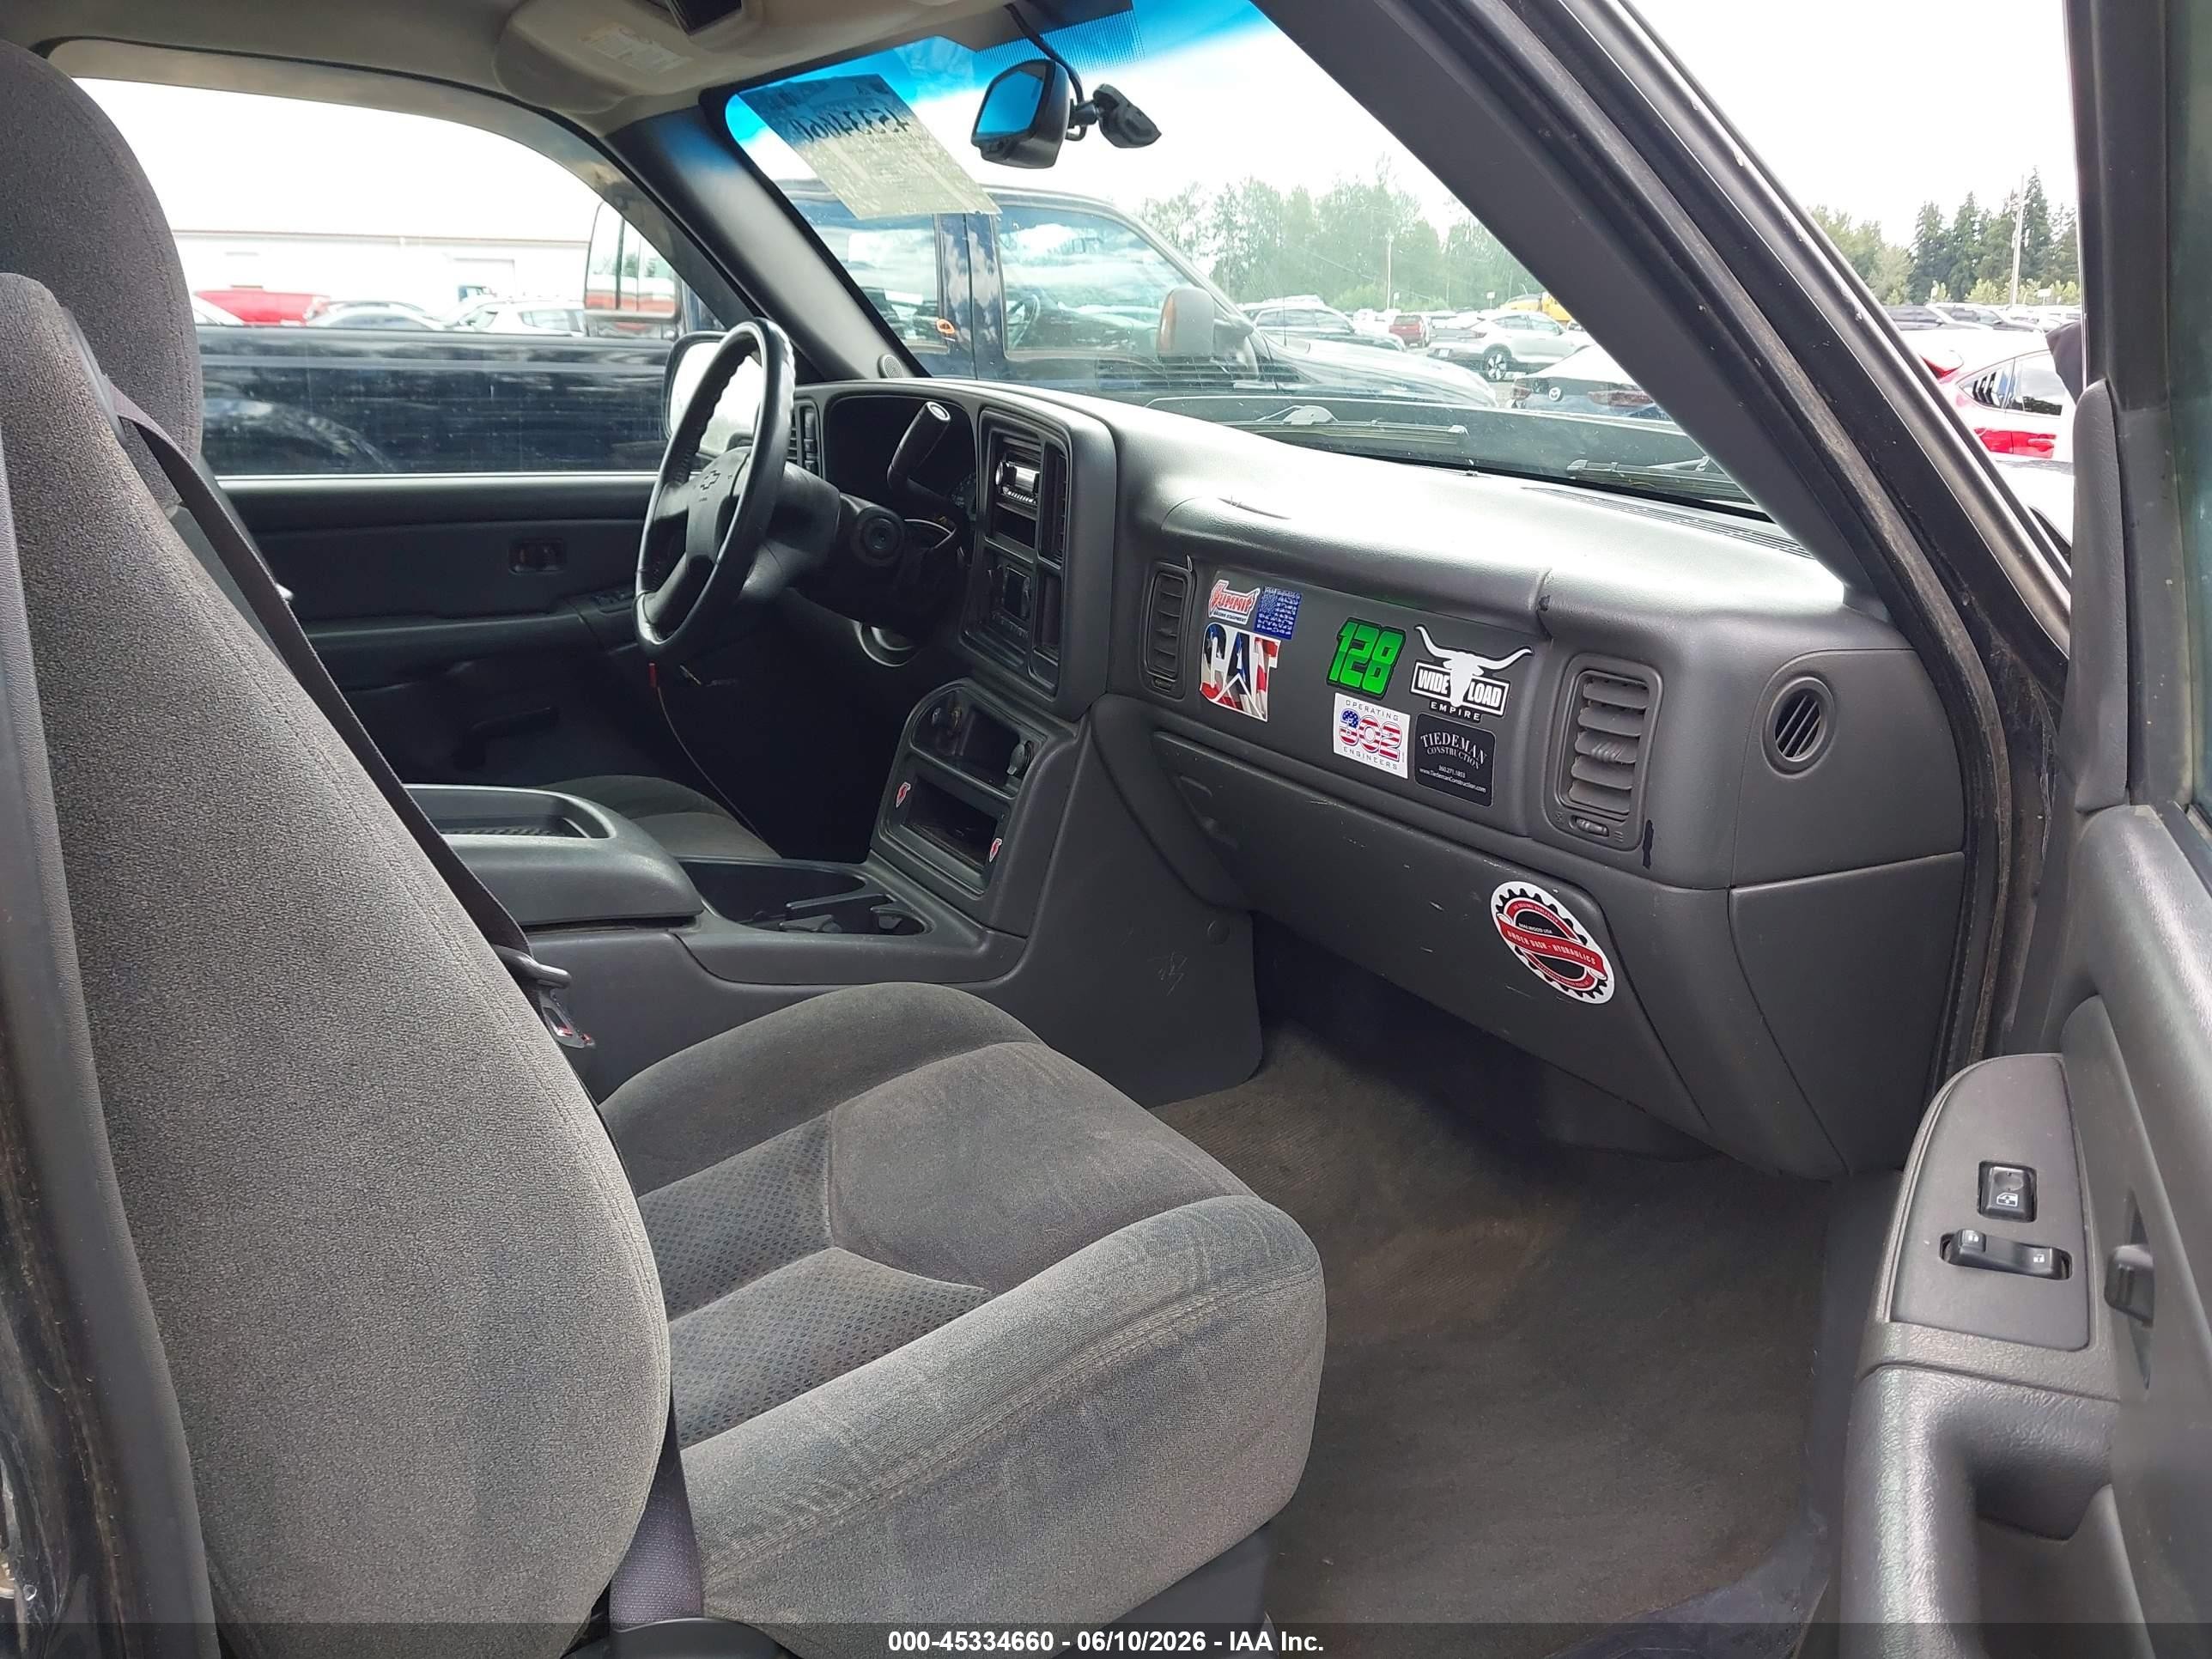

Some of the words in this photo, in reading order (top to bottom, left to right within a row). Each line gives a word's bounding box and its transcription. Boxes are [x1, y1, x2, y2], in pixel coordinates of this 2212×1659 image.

[1211, 584, 1256, 613] SUMMIT
[1201, 623, 1279, 720] CAT
[1328, 621, 1404, 695] 128
[1419, 669, 1449, 695] WIDE
[1468, 682, 1502, 708] LOAD
[1346, 699, 1400, 721] OPERATING
[1431, 702, 1480, 721] EMPIRE
[1339, 708, 1402, 762] 302
[1420, 732, 1487, 765] TIEDEMAN
[1343, 746, 1398, 770] ENGINEERS
[1427, 746, 1481, 769] CONSTRUCTION
[1507, 930, 1529, 946] UNDER
[1553, 944, 1596, 965] HYDRAULICS
